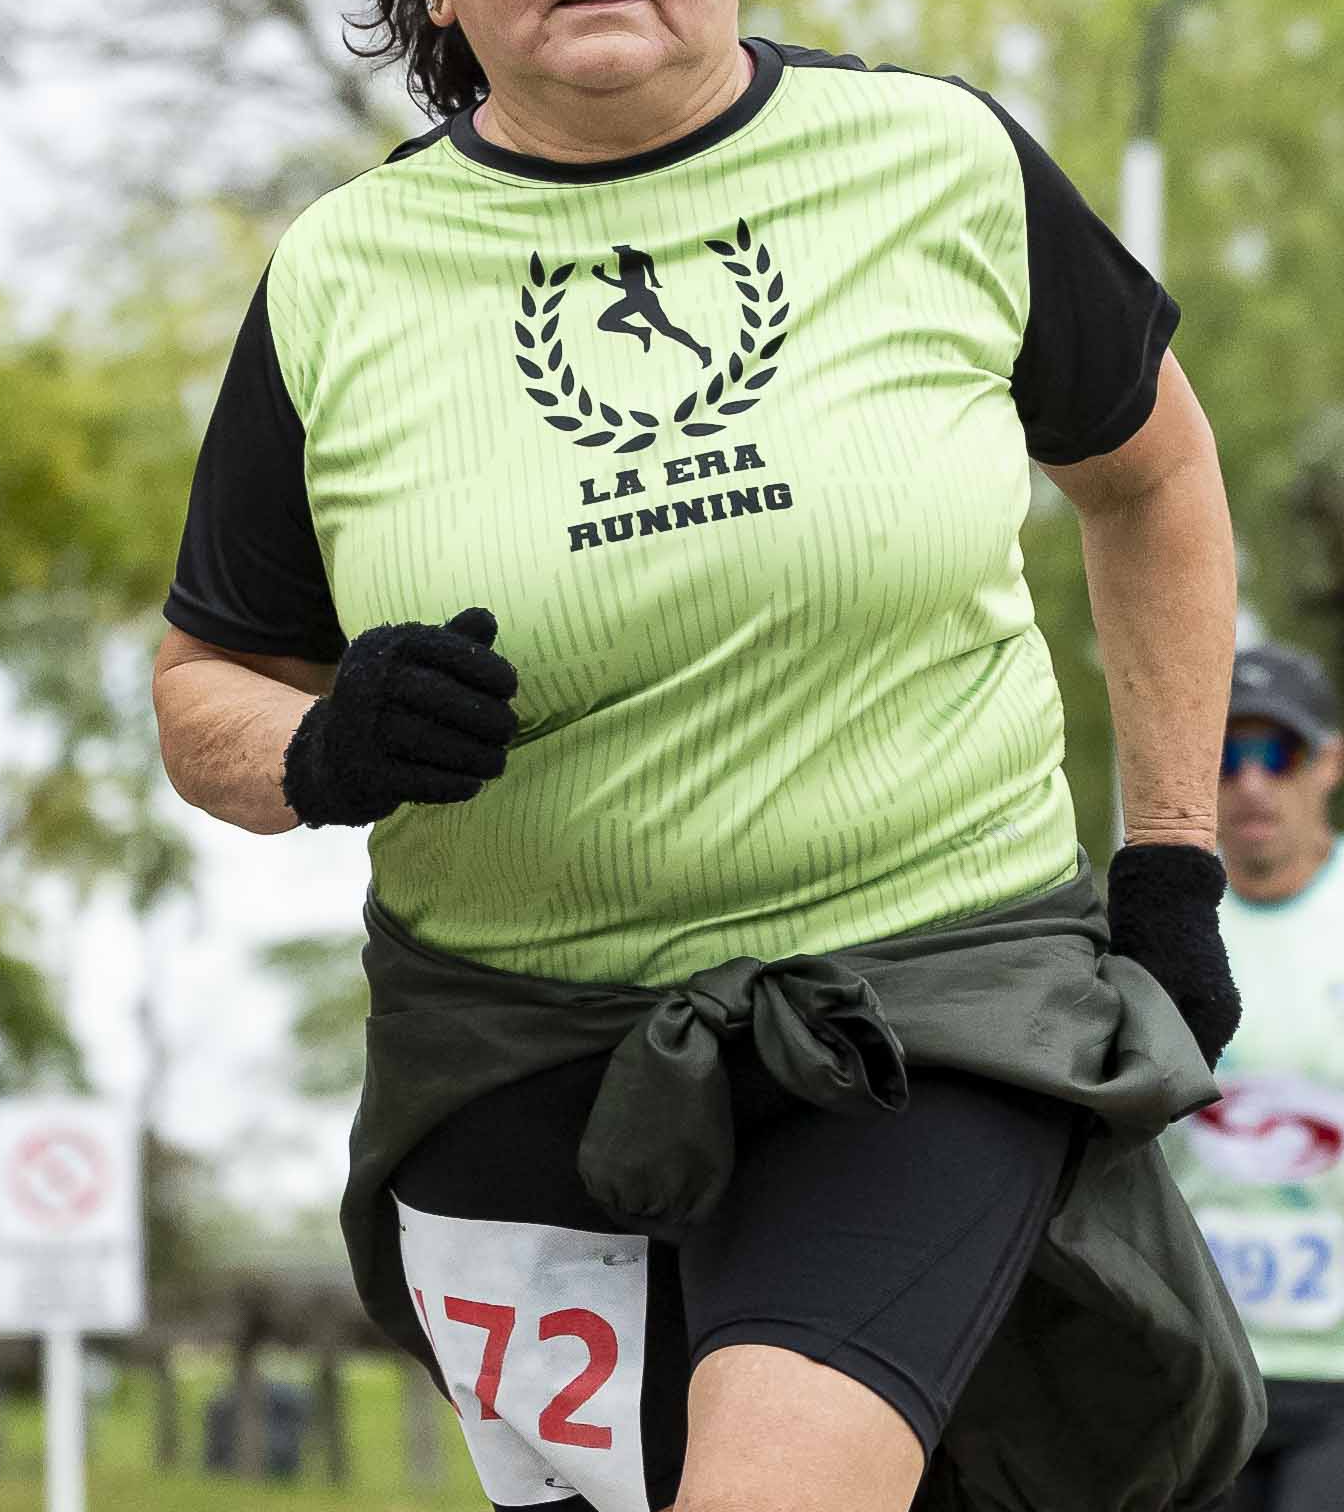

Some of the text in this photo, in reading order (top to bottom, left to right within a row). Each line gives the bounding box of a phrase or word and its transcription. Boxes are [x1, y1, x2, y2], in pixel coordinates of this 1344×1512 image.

[580, 444, 766, 506] LA ERA
[567, 482, 793, 552] RUNNING
[414, 1287, 618, 1450] 72
